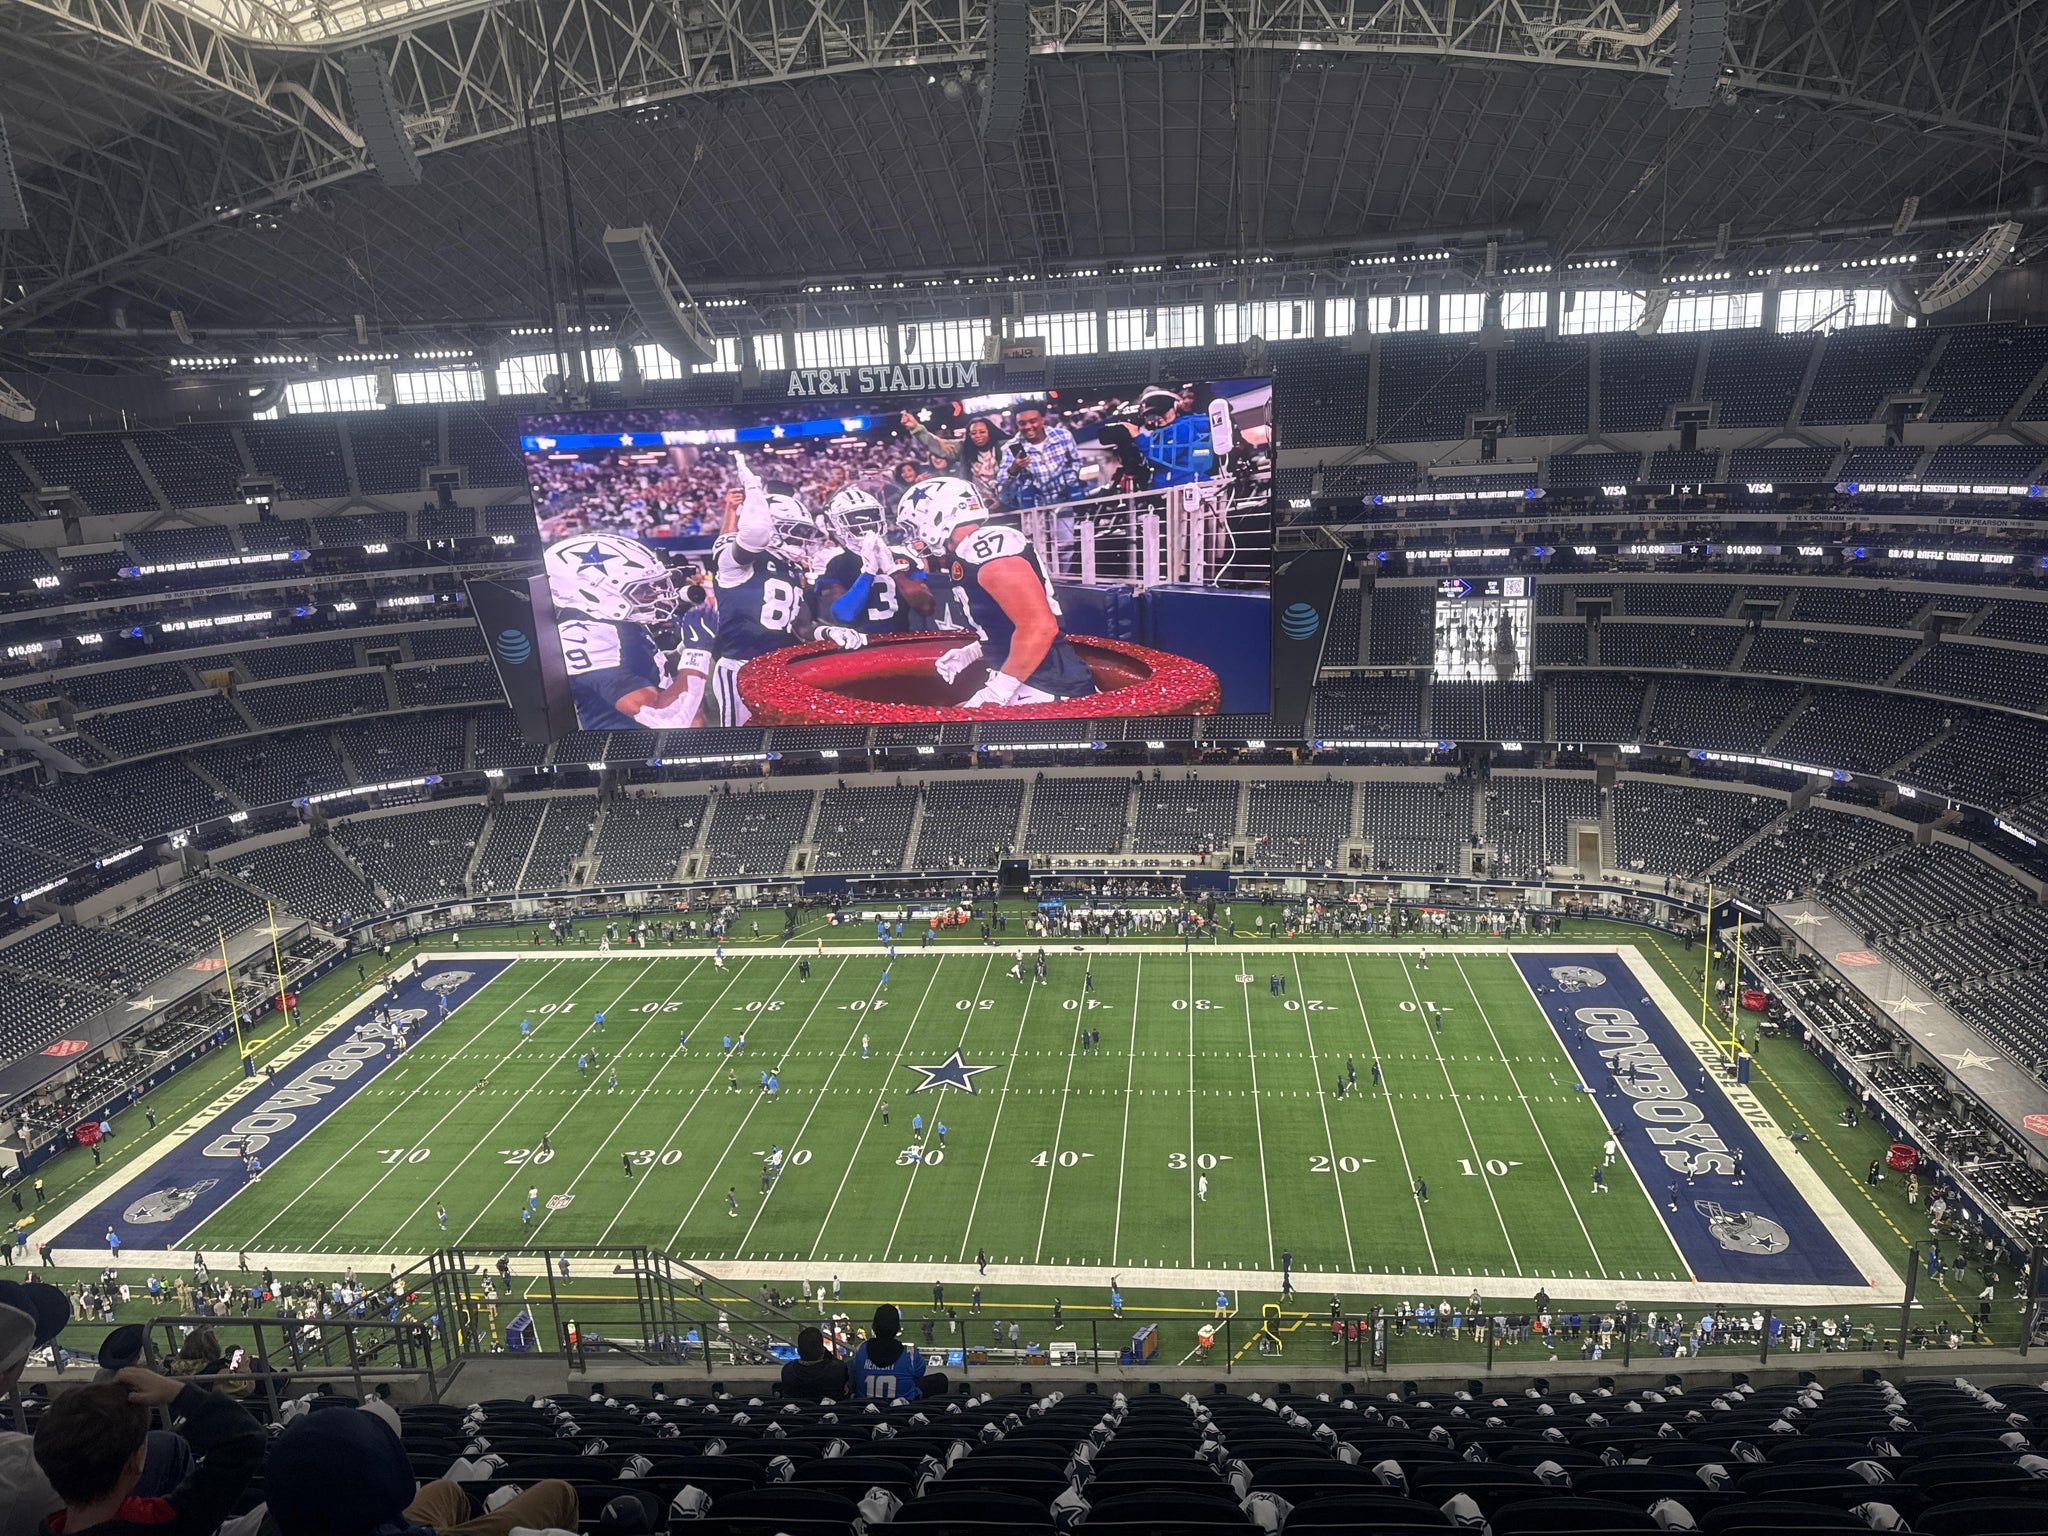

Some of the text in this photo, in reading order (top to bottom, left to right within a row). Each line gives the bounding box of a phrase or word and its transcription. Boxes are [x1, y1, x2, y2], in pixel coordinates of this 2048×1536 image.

[787, 362, 980, 396] AT&T STADIUM
[1601, 486, 1627, 496] VISA
[1747, 483, 1773, 494] VISA
[1288, 500, 1311, 508] VISA
[492, 536, 515, 544] VISA
[973, 534, 1004, 560] 87
[363, 544, 388, 554] VISA
[1573, 546, 1597, 555] VISA
[1631, 545, 1665, 554] $10,690
[1727, 545, 1762, 555] $10,690
[1798, 546, 1824, 556] VISA
[33, 576, 60, 588] VISA
[388, 597, 420, 608] $10,690
[868, 574, 899, 620] 3
[333, 602, 357, 612] VISA
[76, 633, 103, 646] VISA
[8, 643, 42, 658] $10,690
[1501, 742, 1522, 751] VISA
[1619, 745, 1640, 754] VISA
[228, 811, 248, 824] VISA
[1999, 821, 2038, 847] Blockchain.com
[102, 846, 144, 867] Blockchain.com
[21, 876, 68, 901] Blockchain.com
[172, 1124, 198, 1136] IT
[198, 1081, 258, 1118] TAKES
[291, 1040, 312, 1055] OF
[311, 1023, 338, 1036] US
[202, 1008, 428, 1157] COWBOYS
[1575, 1008, 1736, 1175] COWBOYS
[1730, 1094, 1774, 1128] LOVE
[381, 1148, 432, 1164] 10
[504, 1149, 554, 1165] 20
[633, 1150, 682, 1166] 30
[1030, 1150, 1078, 1167] 40
[1168, 1152, 1217, 1170] 30
[1309, 1156, 1360, 1172] 20
[1457, 1159, 1508, 1176] 10
[864, 1375, 897, 1399] 10
